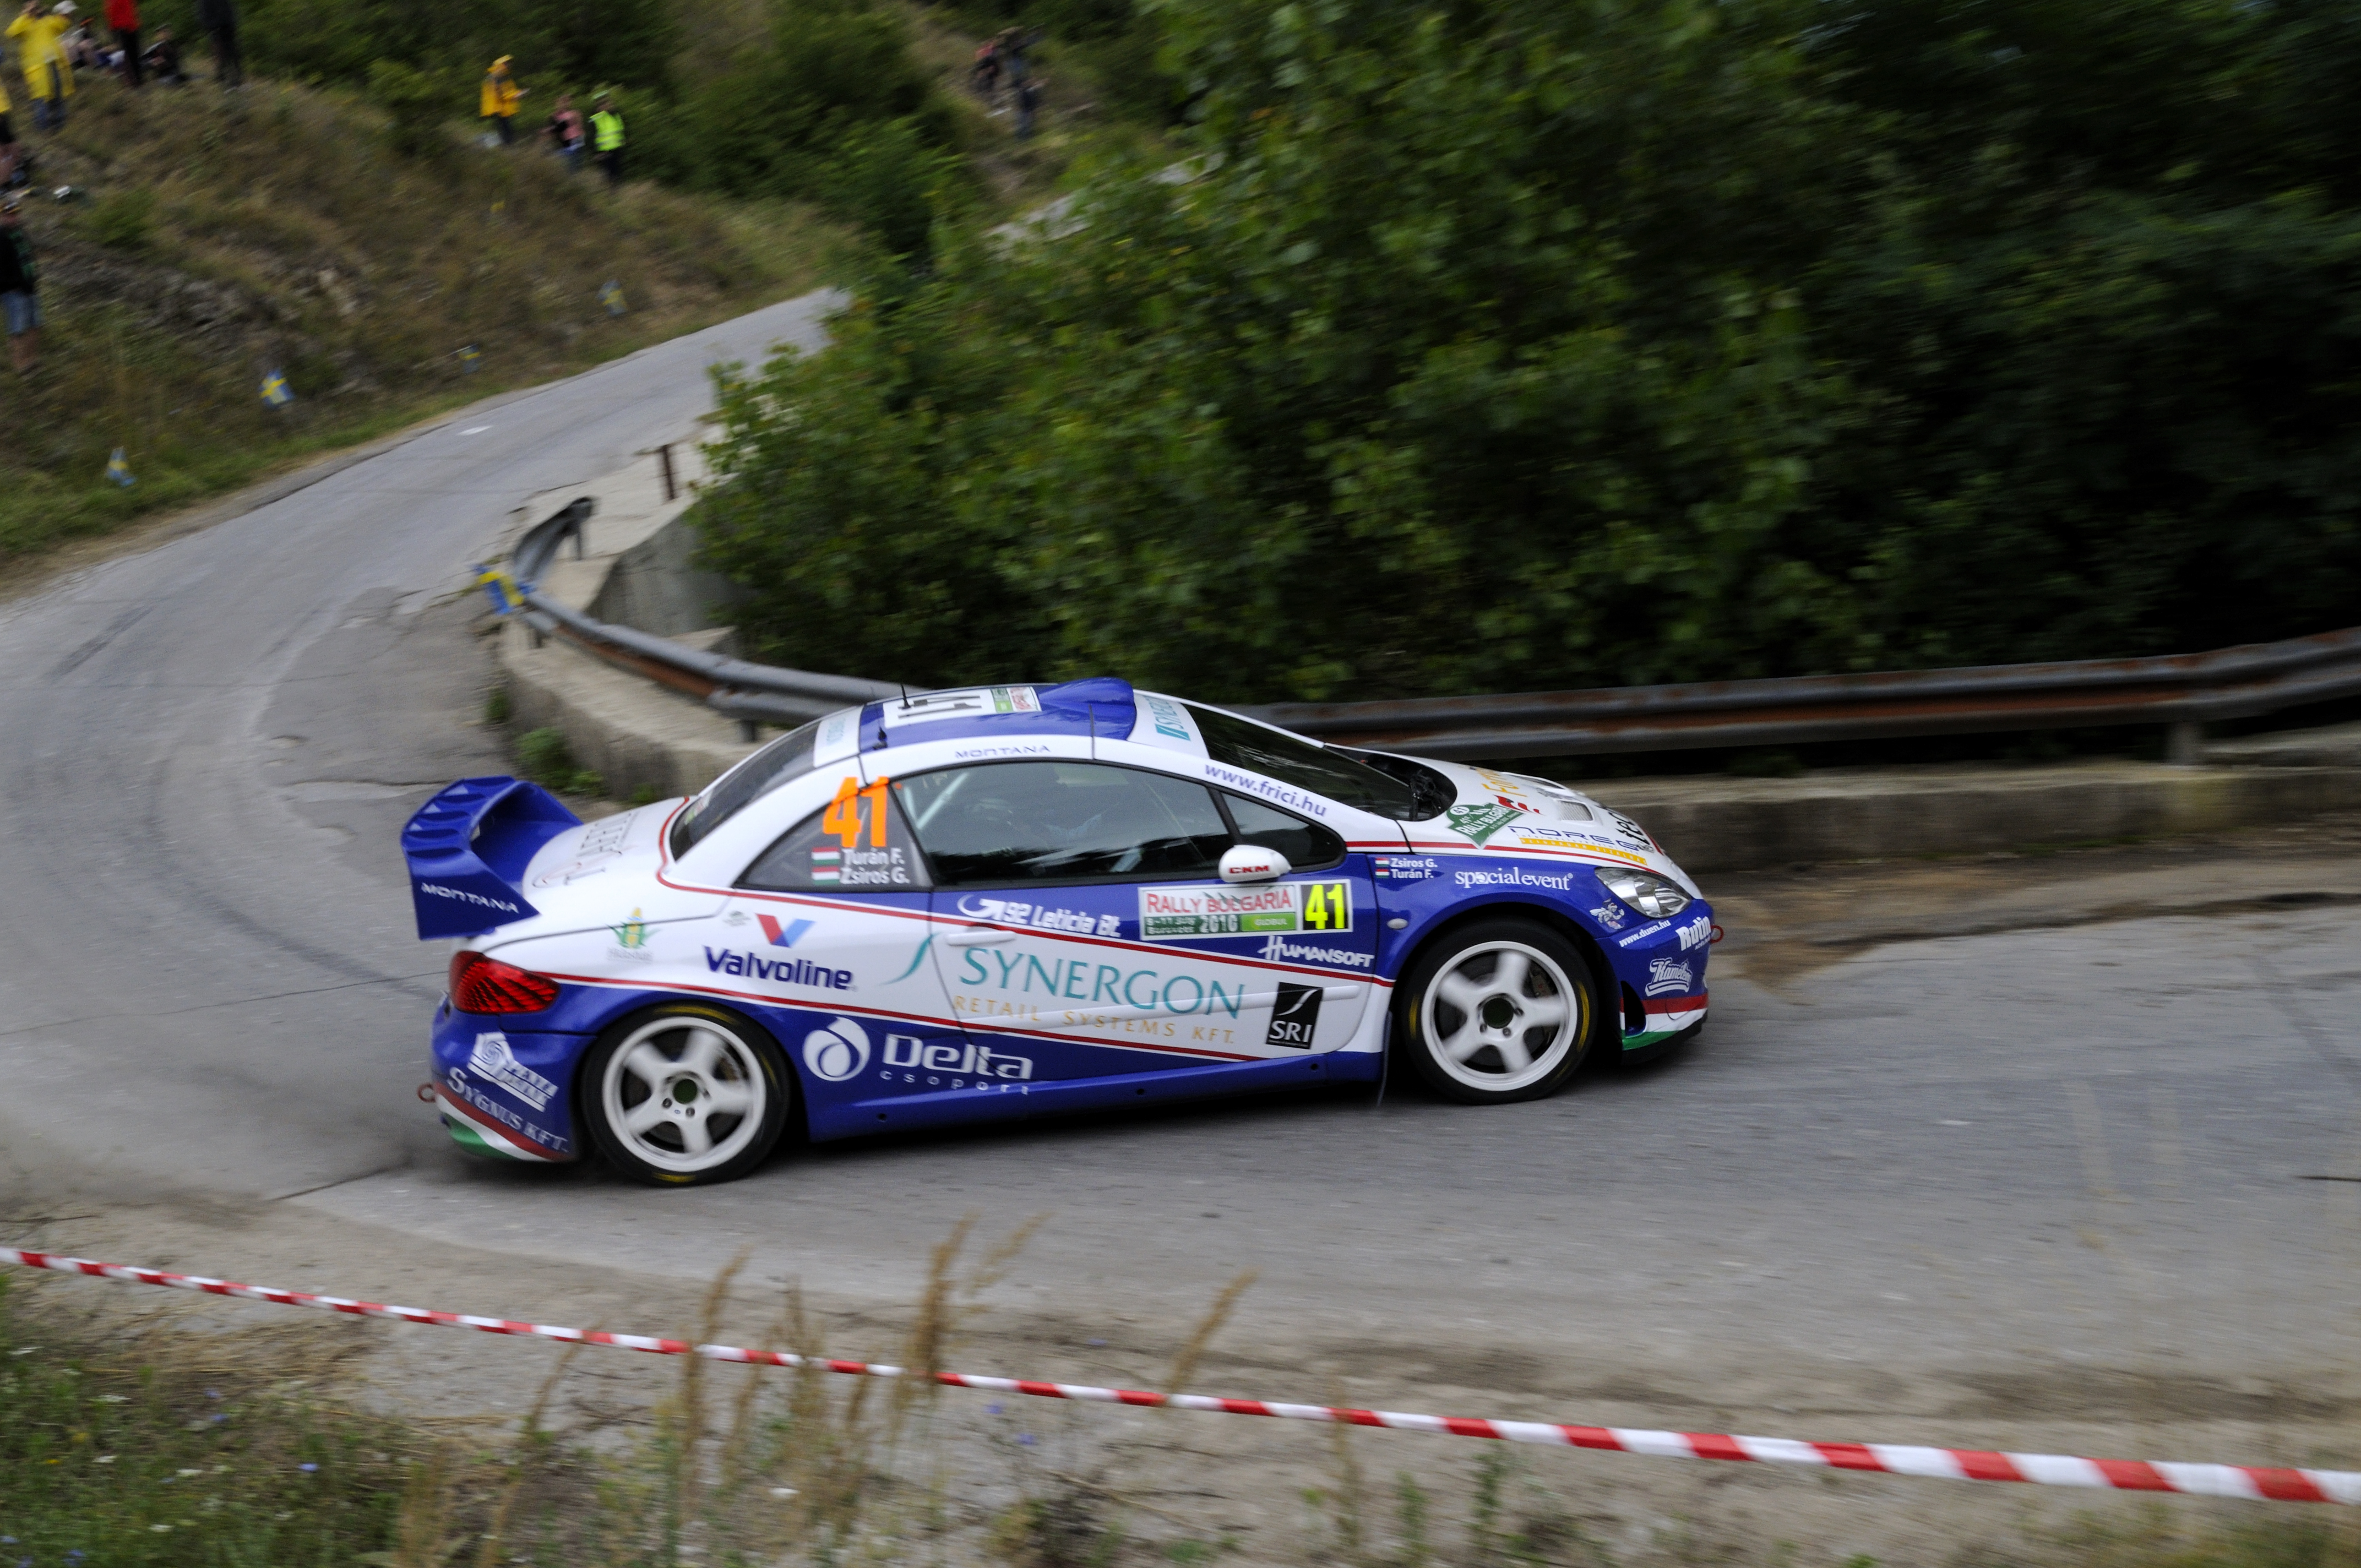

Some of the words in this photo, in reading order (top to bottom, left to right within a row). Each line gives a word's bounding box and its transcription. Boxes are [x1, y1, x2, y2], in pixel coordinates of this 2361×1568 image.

[955, 745, 1051, 758] MONTANA
[1205, 764, 1328, 817] www.frici.hu
[823, 776, 890, 848] 41
[1455, 819, 1489, 836] RALLY
[890, 847, 906, 865] F.
[1229, 865, 1270, 874] CKM
[1426, 858, 1438, 868] G.
[1391, 868, 1424, 879] Turán
[1424, 869, 1434, 879] F.
[421, 882, 519, 914] MONTANA
[1146, 892, 1201, 913] RALLY
[1207, 889, 1292, 912] BULGARIA
[1305, 884, 1345, 930] 41
[1031, 906, 1096, 934] Leticia
[1199, 914, 1239, 933] 2010
[1619, 919, 1672, 948] www.duen.hu
[1675, 916, 1711, 951] Rutin
[703, 945, 853, 990] Valvoline
[960, 947, 1245, 1019] SYNERGON
[954, 995, 1042, 1022] RETAIL
[1064, 1010, 1176, 1037] SYSTEMS
[1193, 1026, 1235, 1043] KFT.
[1269, 1020, 1313, 1043] SRI
[883, 1033, 1033, 1080] Delta
[880, 1070, 1029, 1095] csoport
